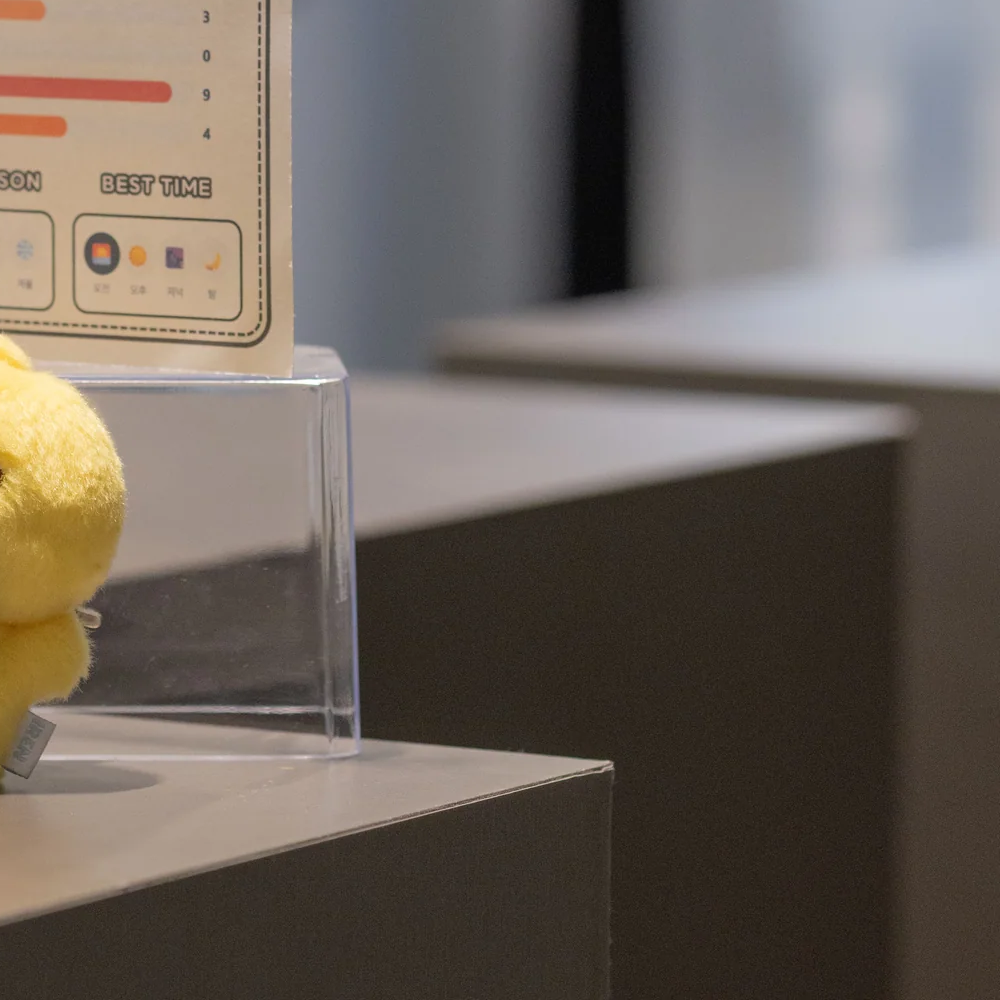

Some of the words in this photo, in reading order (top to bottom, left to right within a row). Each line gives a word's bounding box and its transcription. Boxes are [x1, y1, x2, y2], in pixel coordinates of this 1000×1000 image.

[203, 10, 210, 24] 3
[202, 49, 211, 62] 0
[202, 89, 211, 101] 9
[202, 128, 211, 140] 4
[100, 173, 155, 196] BEST
[159, 175, 212, 199] TIME
